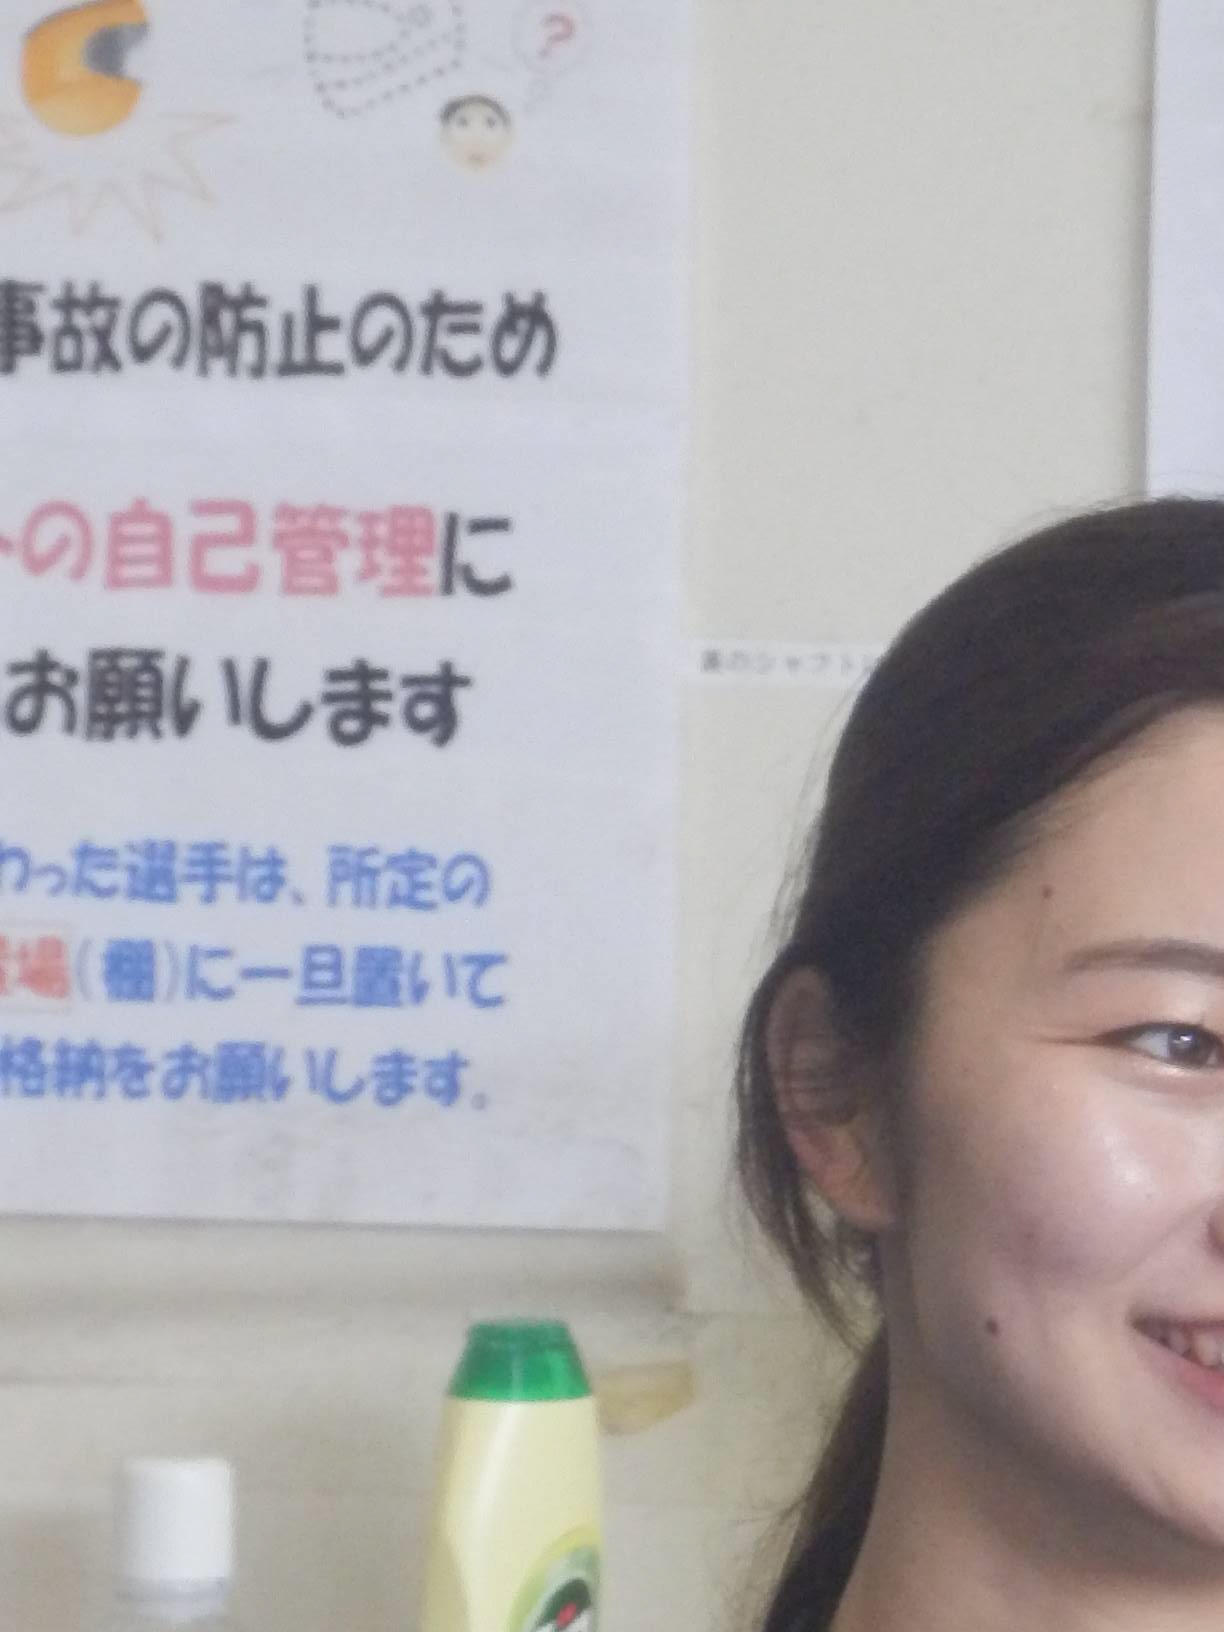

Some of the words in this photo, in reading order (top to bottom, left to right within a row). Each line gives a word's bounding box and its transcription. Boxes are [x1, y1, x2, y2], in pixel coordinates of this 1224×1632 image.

[0, 499, 513, 597] の自己管理に
[3, 645, 473, 748] お願いします
